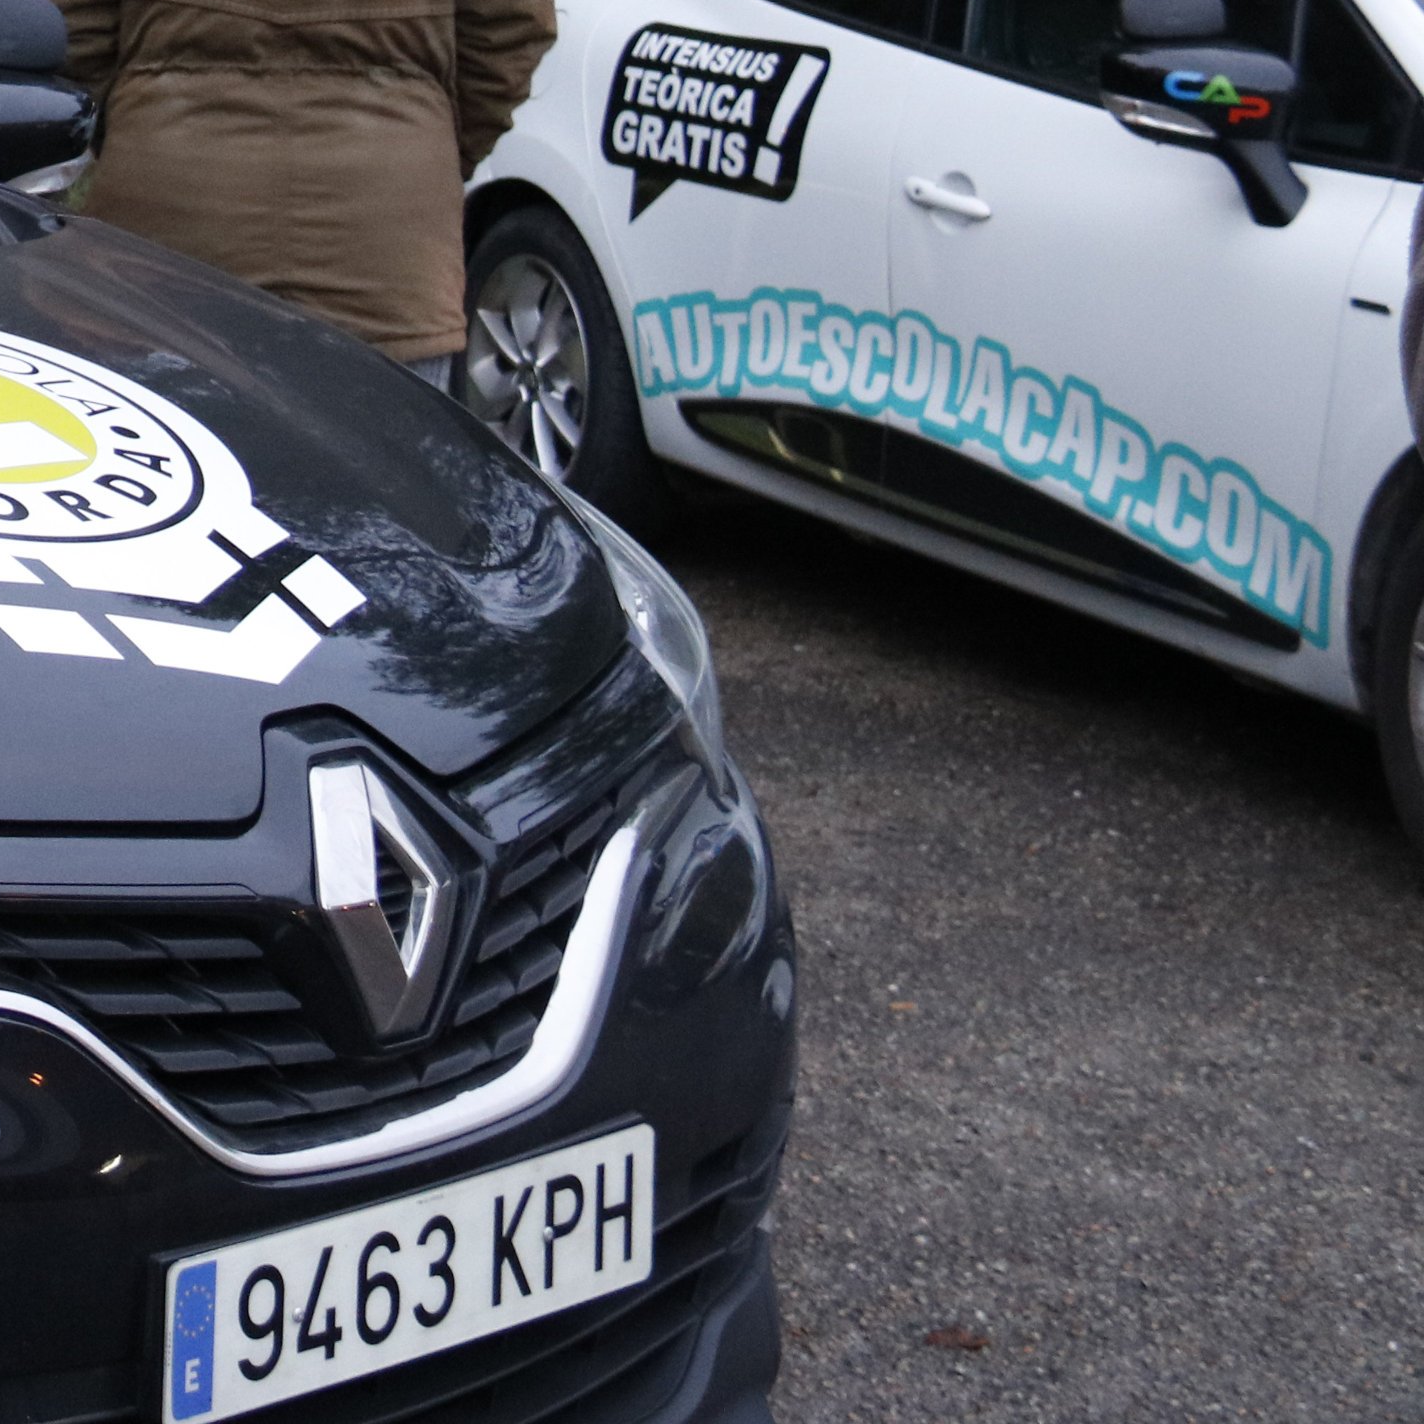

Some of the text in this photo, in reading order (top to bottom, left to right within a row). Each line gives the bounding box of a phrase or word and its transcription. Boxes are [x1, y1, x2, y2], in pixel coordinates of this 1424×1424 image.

[631, 30, 781, 83] INTENSIUS
[623, 65, 755, 126] TEÒRICA
[1162, 69, 1272, 124] CAP
[635, 287, 1332, 648] AUTOESCOLACAP.COM
[237, 1152, 634, 1382] 9463 KPH
[184, 1357, 201, 1394] E
